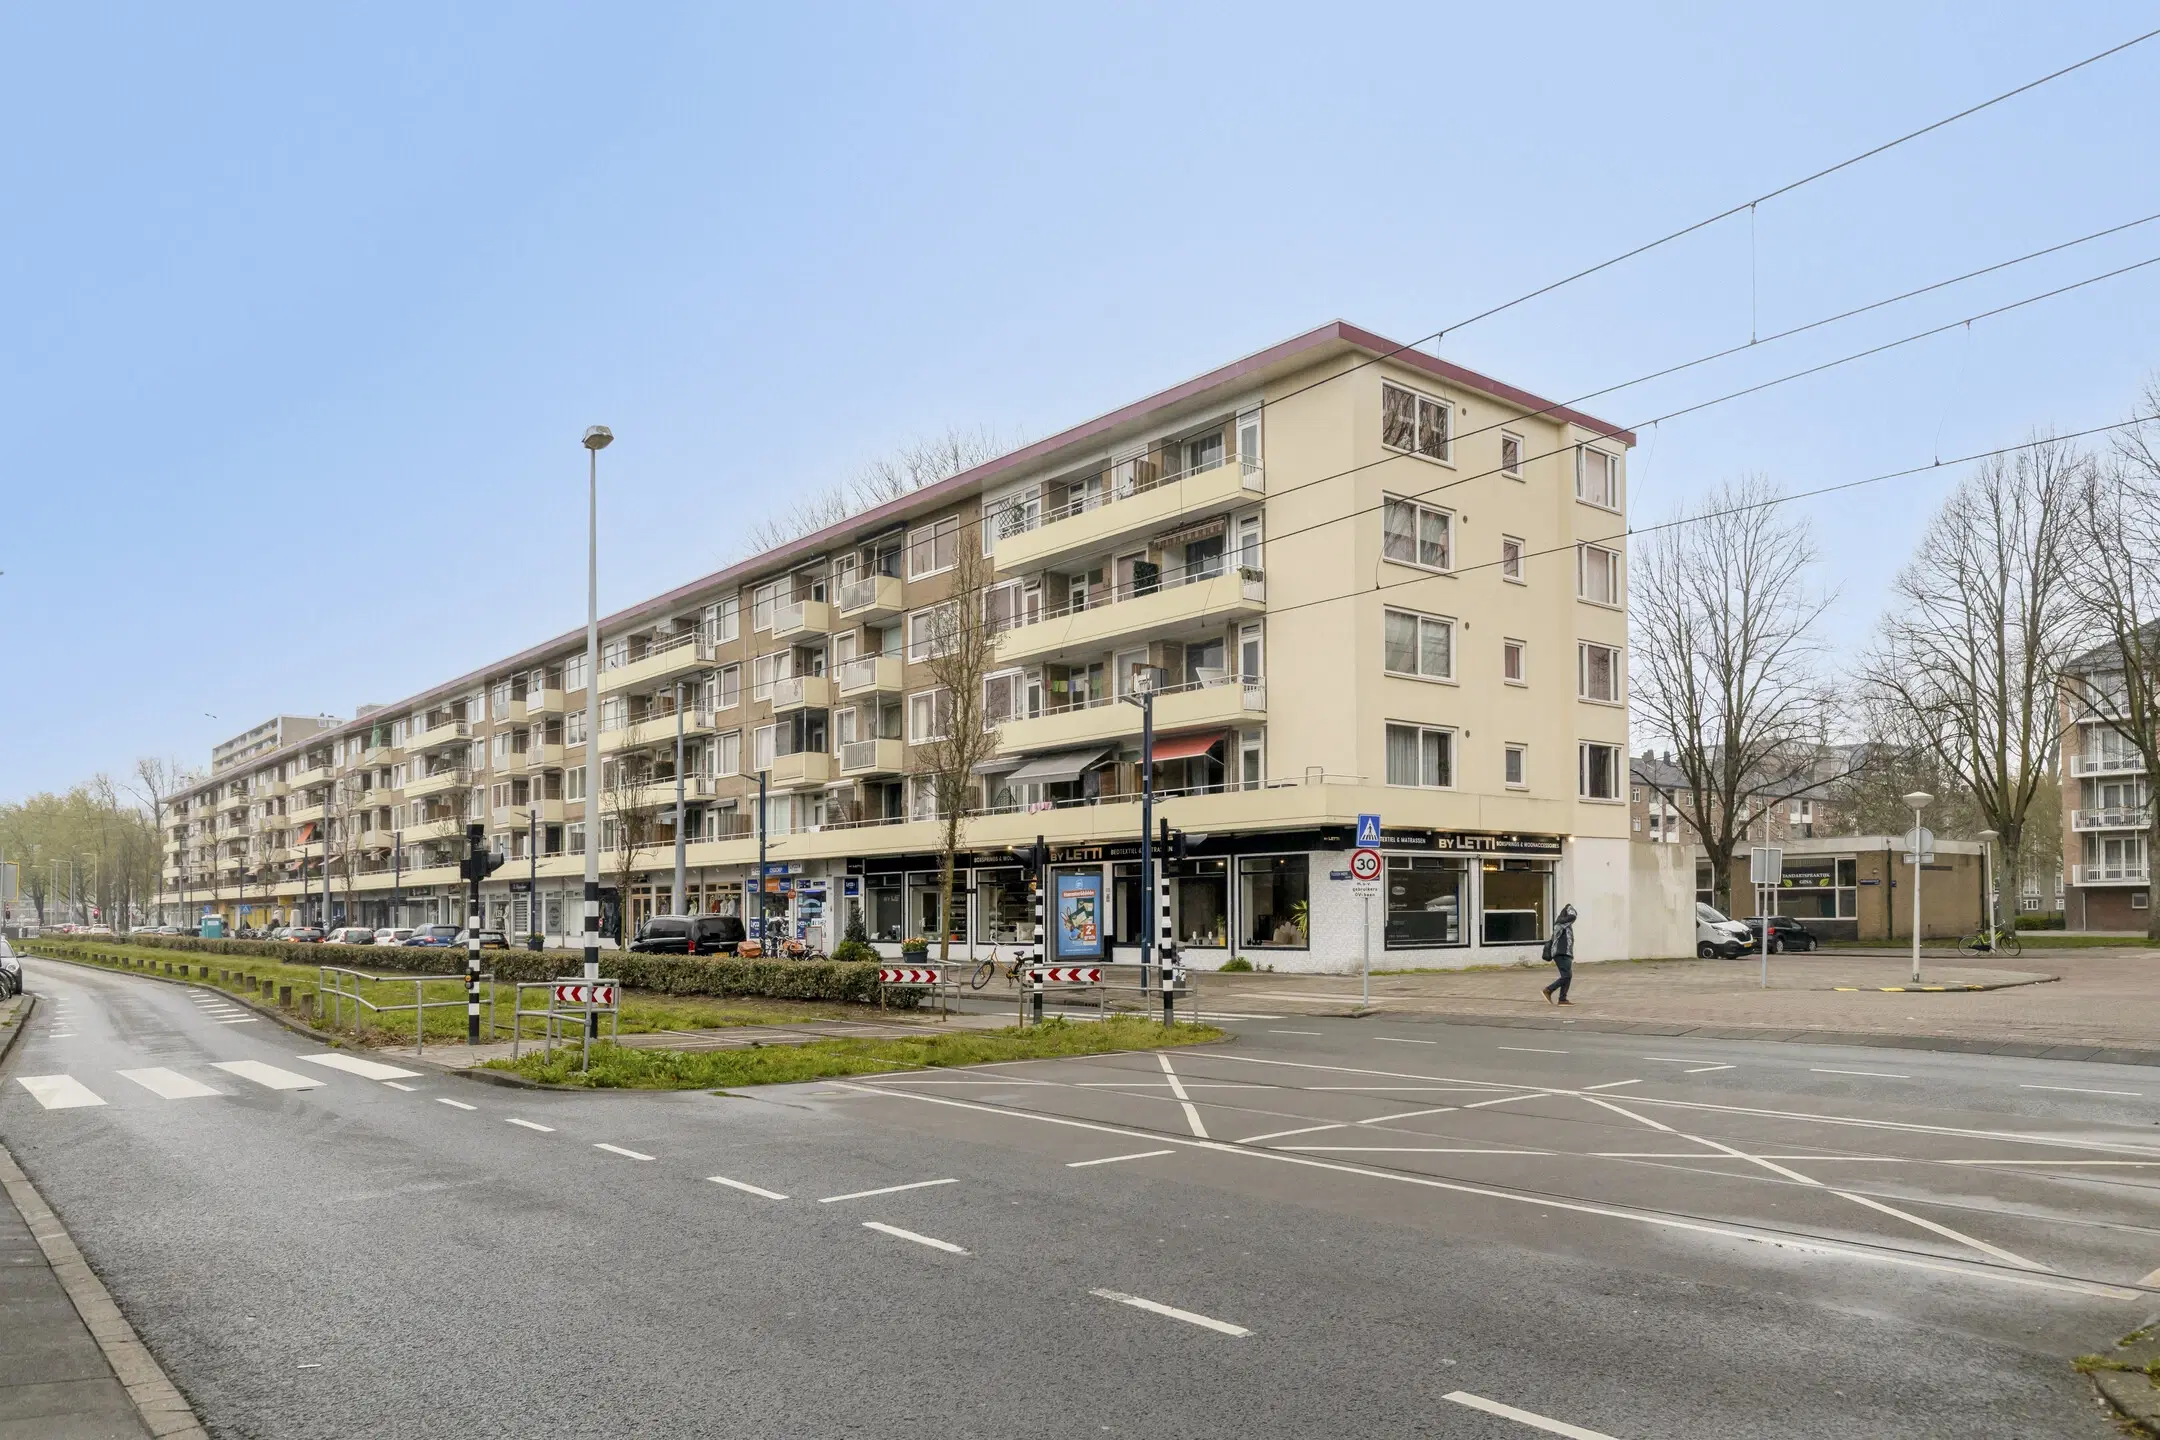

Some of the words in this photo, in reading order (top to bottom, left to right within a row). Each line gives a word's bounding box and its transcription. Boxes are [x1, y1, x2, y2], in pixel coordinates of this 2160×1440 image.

[1438, 838, 1454, 849] BY
[1456, 835, 1496, 850] LETTI
[1050, 853, 1064, 862] BY
[1066, 847, 1102, 861] LETTI
[1356, 858, 1376, 871] 30
